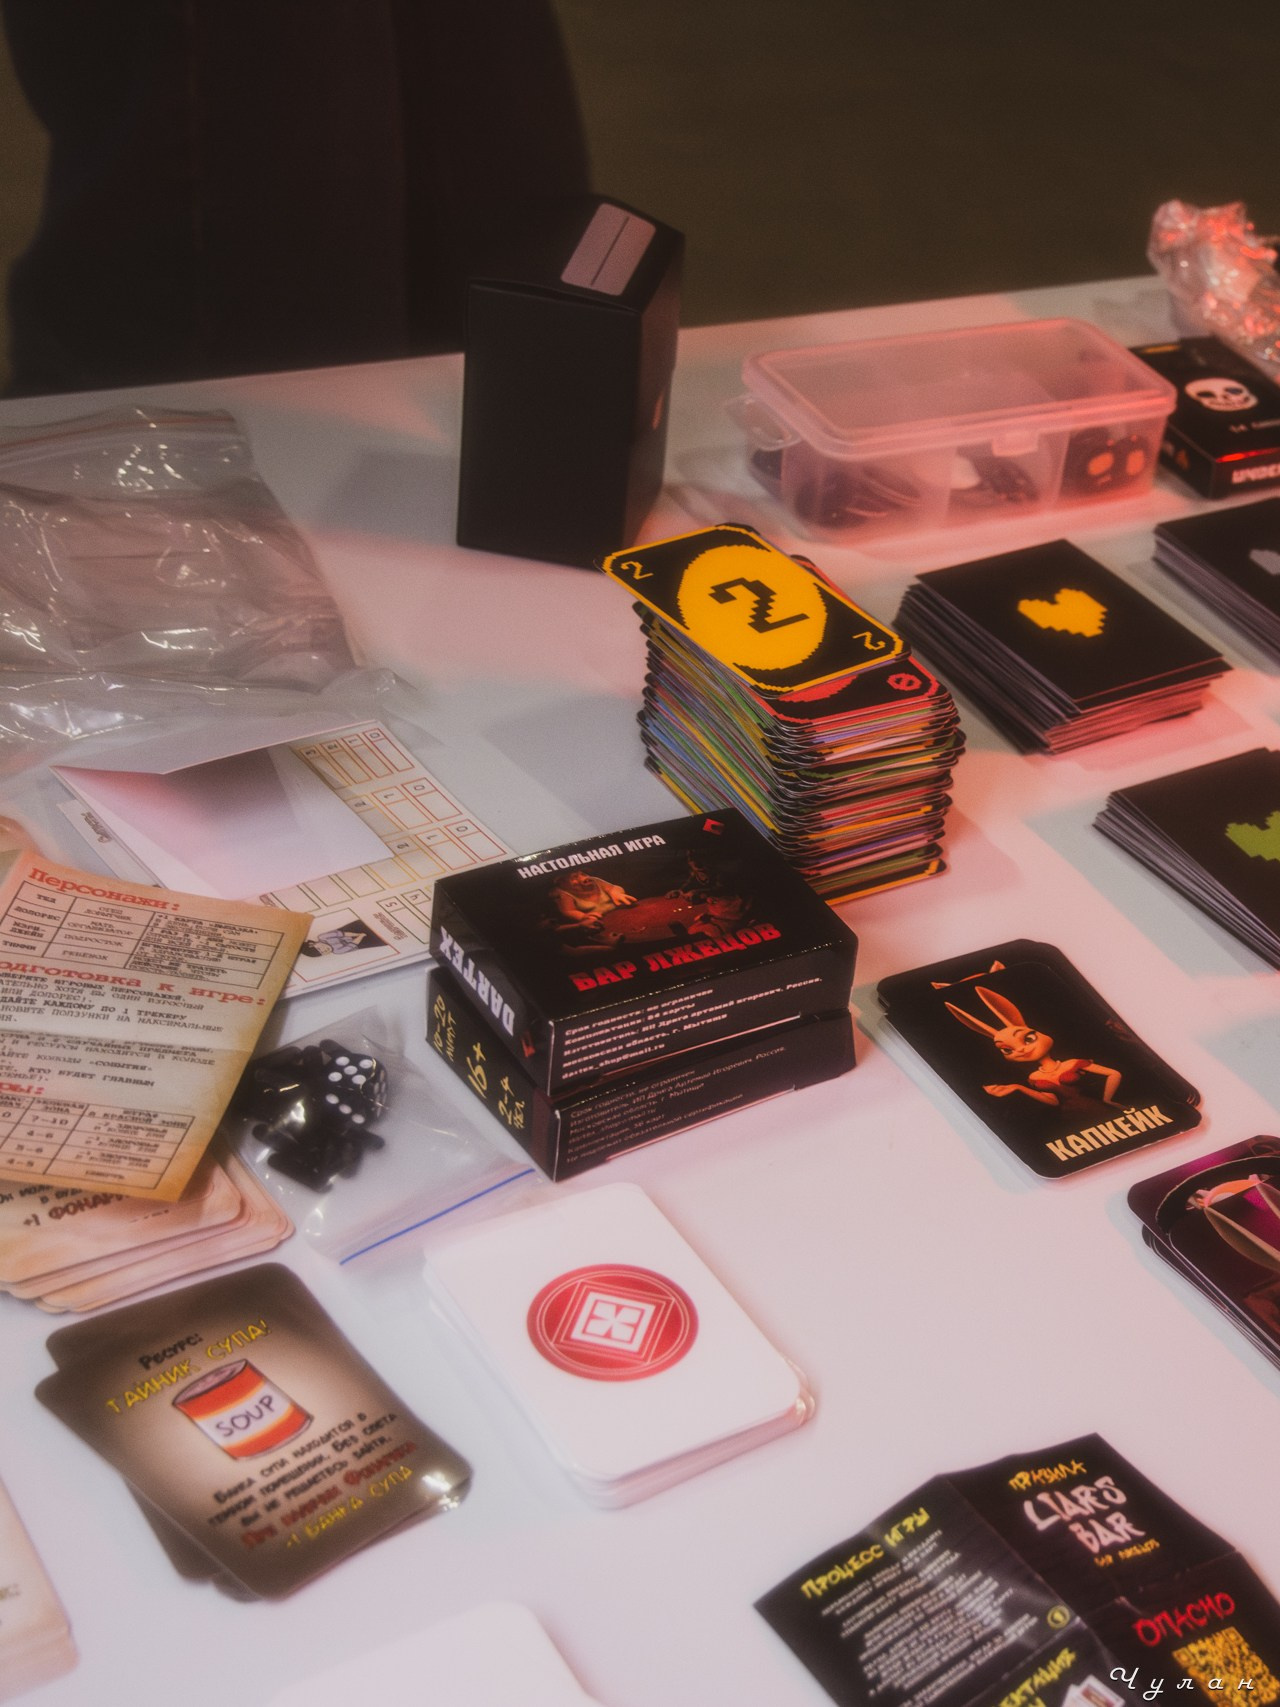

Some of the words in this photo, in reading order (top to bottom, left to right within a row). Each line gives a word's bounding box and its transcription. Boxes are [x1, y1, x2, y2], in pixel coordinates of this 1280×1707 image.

[620, 560, 654, 580] 2
[708, 576, 811, 634] 2
[852, 630, 886, 651] 2
[517, 844, 625, 879] НАСТОЛЬНАЯ
[623, 834, 666, 853] ИГРА
[29, 868, 181, 911] Персонажи:
[568, 960, 638, 993] БАР
[643, 922, 782, 973] ЛЖЕЦОВ
[189, 987, 266, 1006] игре:
[439, 926, 516, 1037] DARTEX
[43, 1000, 95, 1010] КАЖДОМУ
[137, 1009, 187, 1021] ТРЕКЕРУ
[51, 1008, 110, 1020] ПОЛЗУНКИ
[565, 1025, 590, 1036] Срок
[466, 1042, 488, 1099] 16+
[1045, 1105, 1175, 1162] КАПКЕЙК
[206, 1319, 272, 1361] СУПА!
[215, 1394, 276, 1437] SOUP
[368, 1464, 414, 1498] СУПА
[1007, 1459, 1088, 1491] ПРАВИЛА
[1068, 1511, 1147, 1554] BAR
[800, 1544, 885, 1599] ПРОЦЕСС
[1131, 1591, 1237, 1648] ОПАСНО
